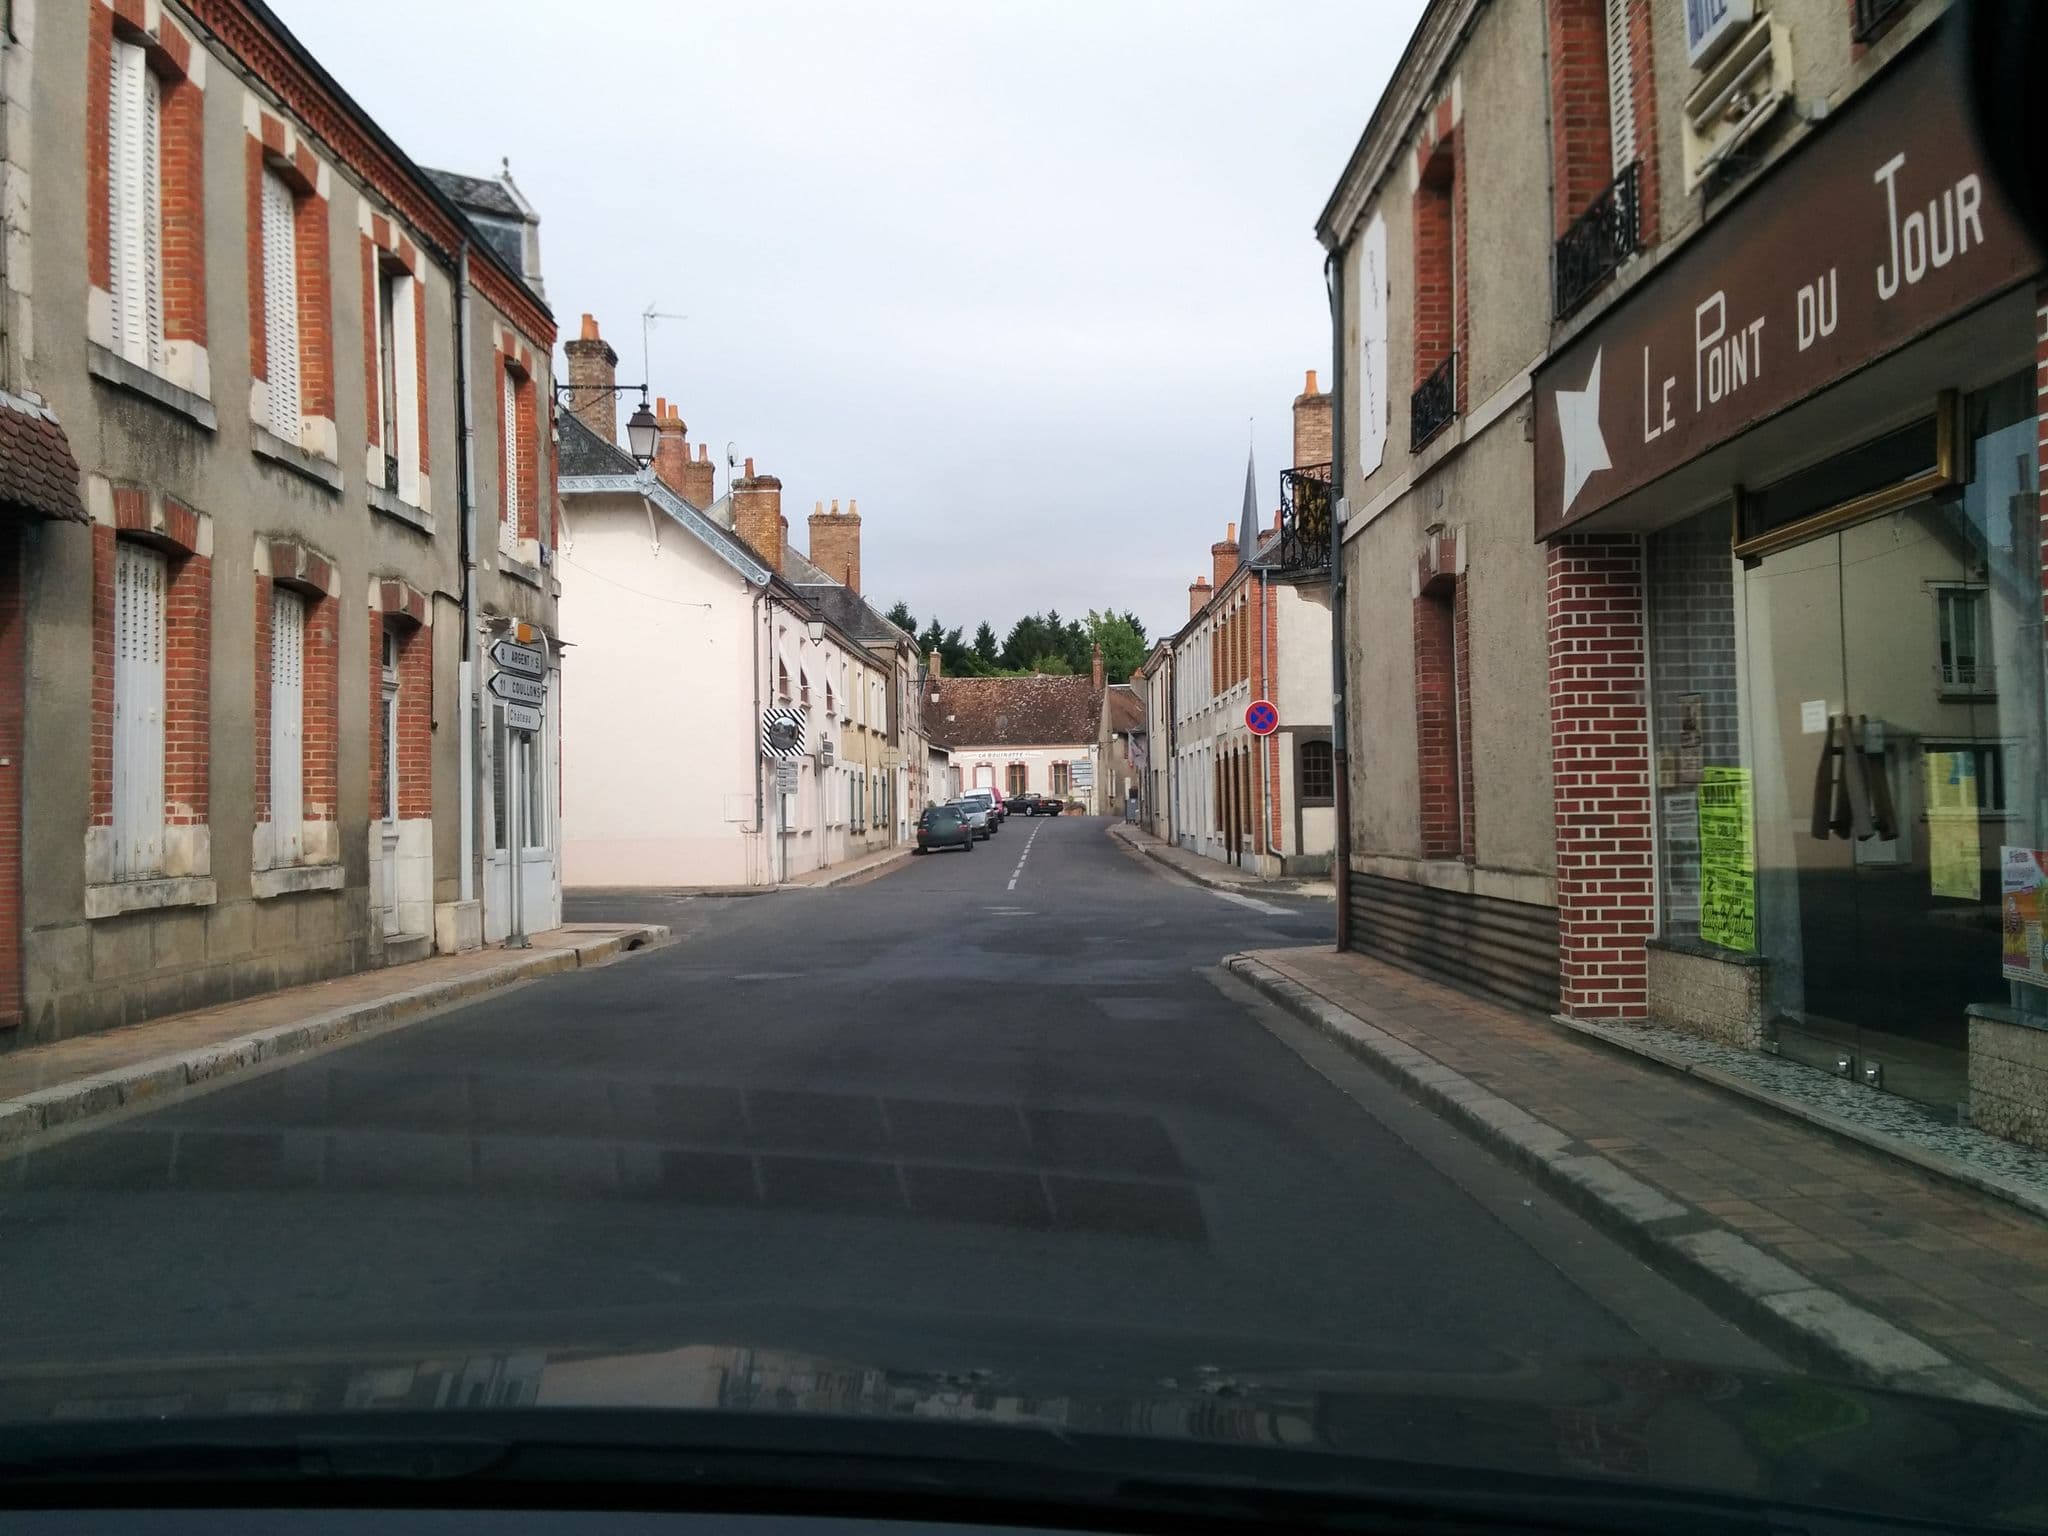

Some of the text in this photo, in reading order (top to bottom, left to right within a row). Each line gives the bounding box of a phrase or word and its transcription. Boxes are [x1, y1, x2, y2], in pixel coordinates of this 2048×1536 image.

[1694, 289, 1766, 412] POINT
[1873, 151, 1985, 301] JOUR
[511, 650, 530, 666] ARGENT
[500, 679, 541, 698] 11 COULLONS
